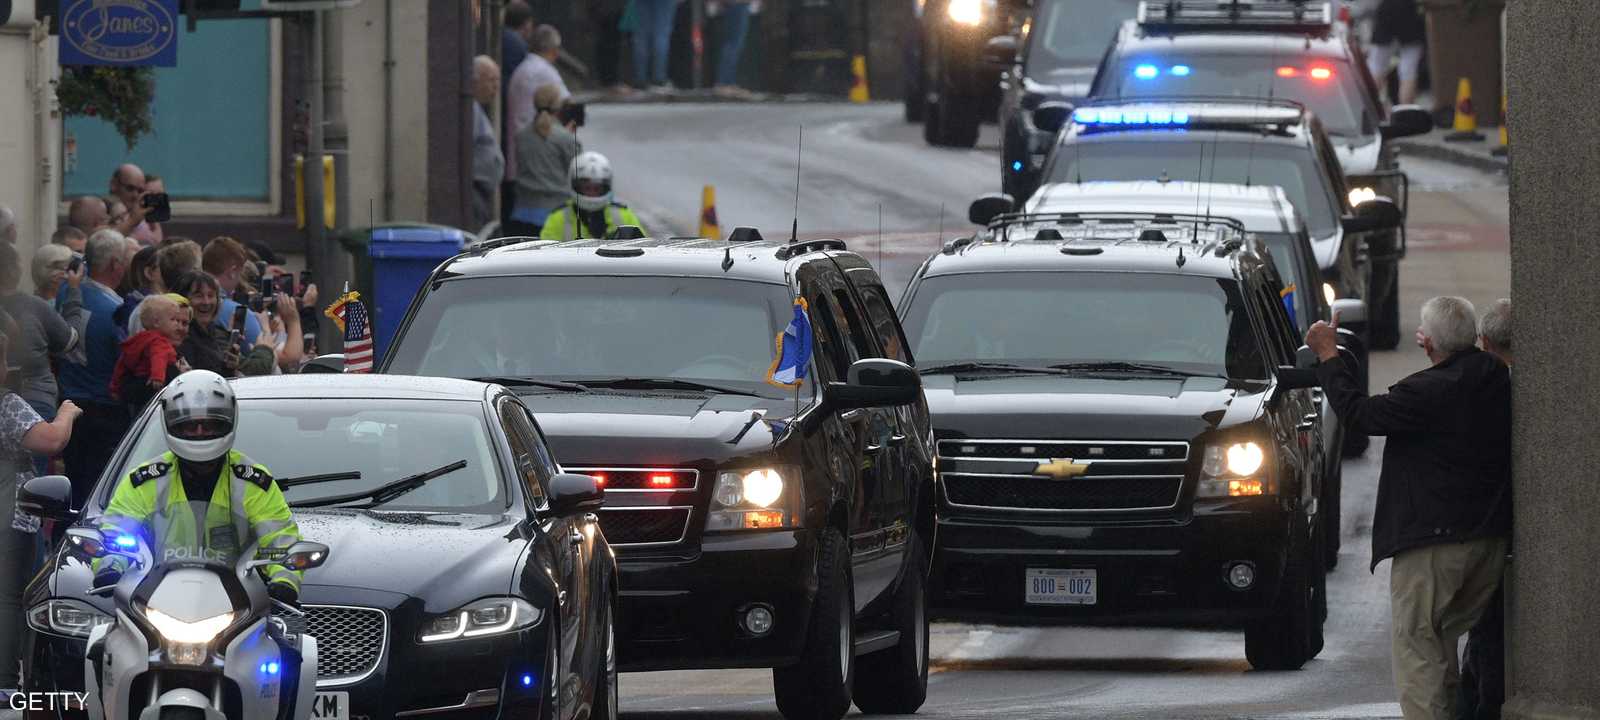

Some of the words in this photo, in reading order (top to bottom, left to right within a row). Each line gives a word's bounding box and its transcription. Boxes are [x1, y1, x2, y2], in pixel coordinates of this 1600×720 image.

[86, 4, 153, 41] Janes
[164, 546, 226, 565] POLICE
[1033, 578, 1055, 594] 800
[1070, 578, 1092, 595] 002
